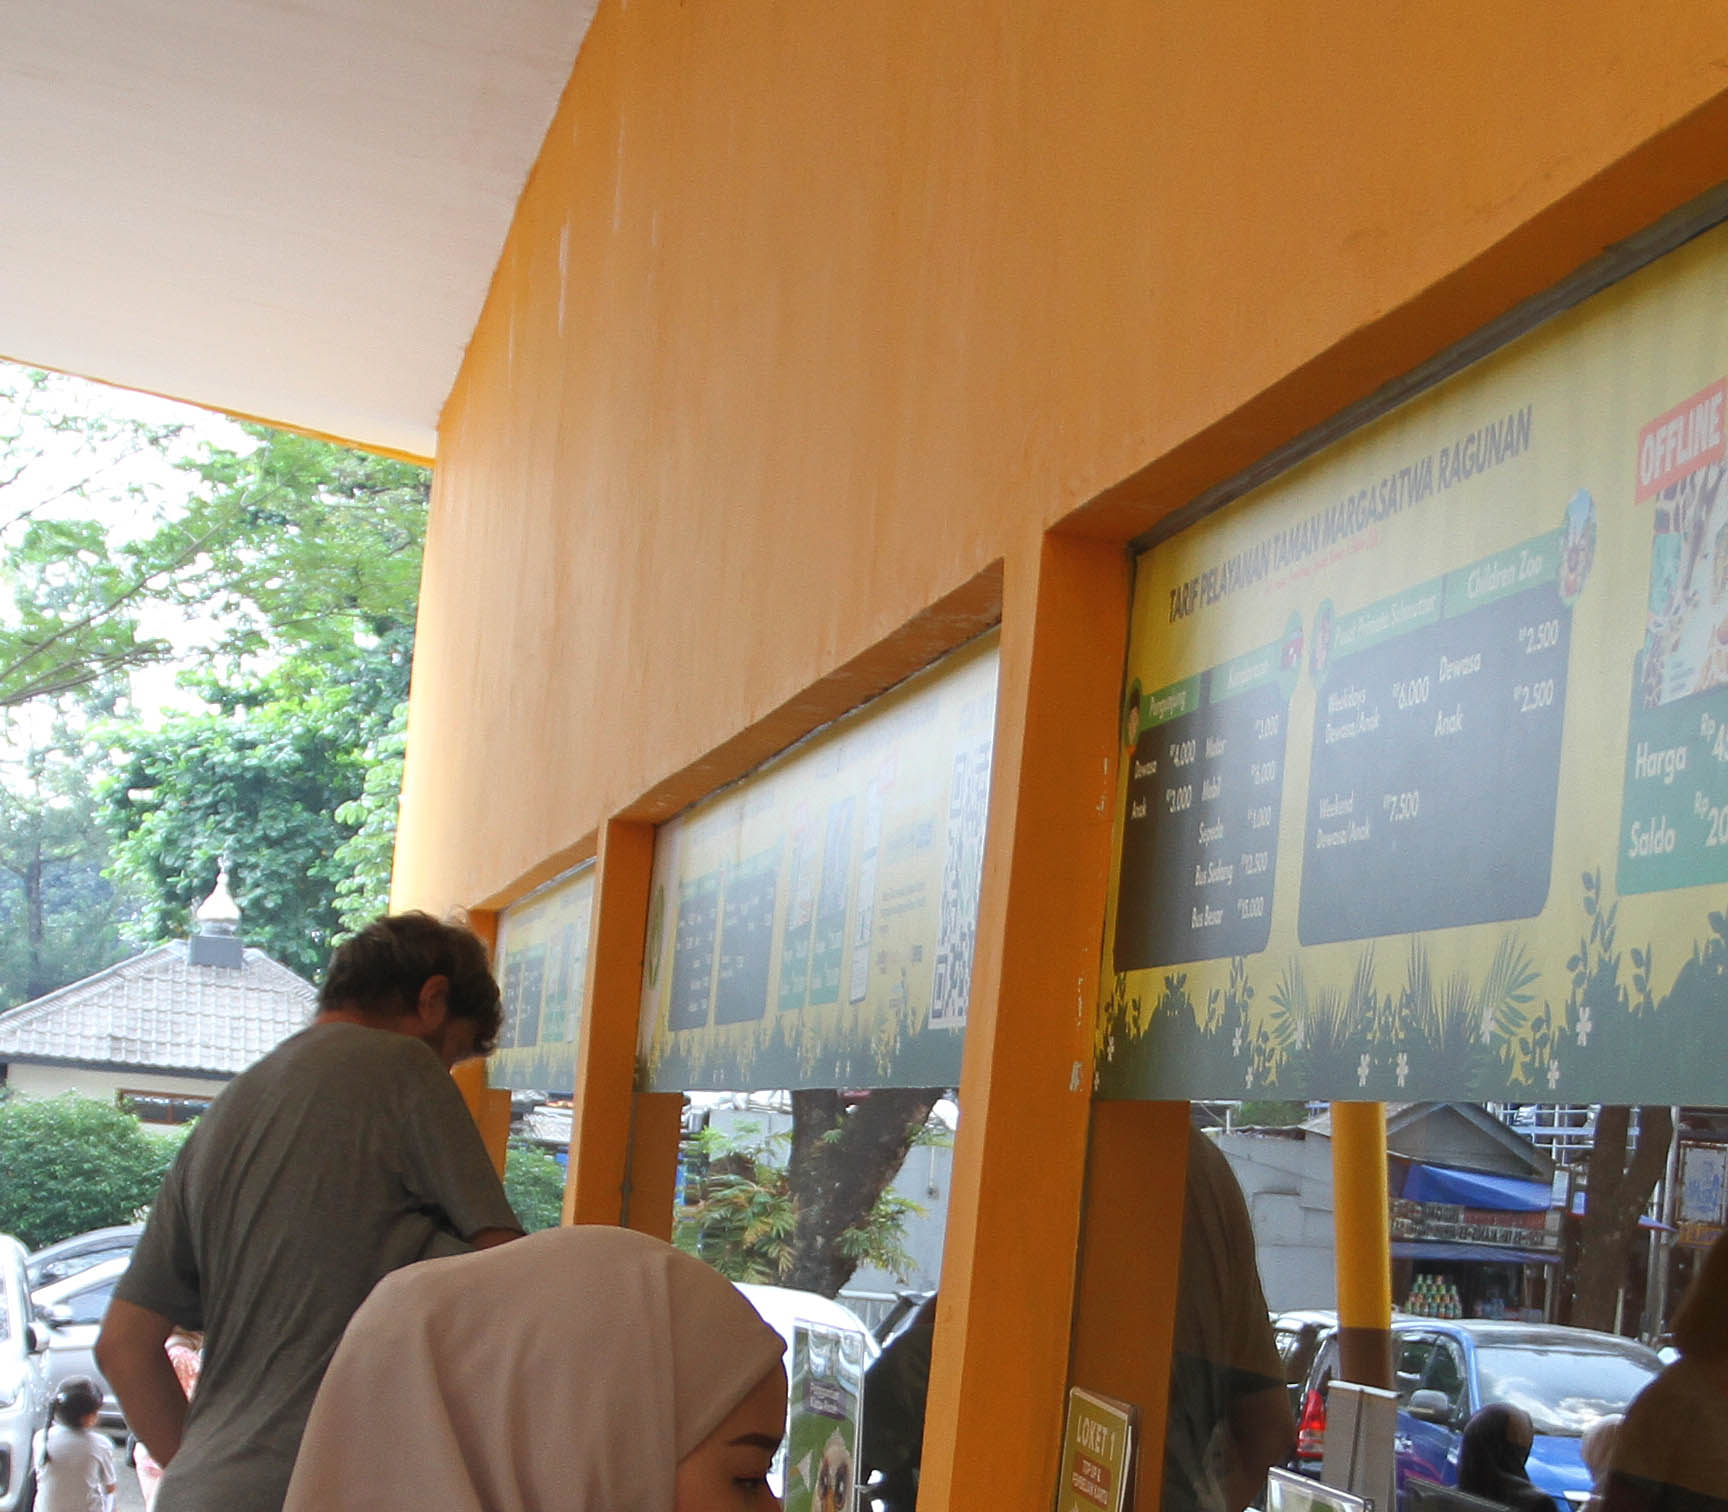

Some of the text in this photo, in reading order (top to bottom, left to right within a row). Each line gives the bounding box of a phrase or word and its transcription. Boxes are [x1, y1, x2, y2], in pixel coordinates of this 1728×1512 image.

[1640, 391, 1723, 487] OFFLINE
[1271, 512, 1321, 571] TAMAN
[1323, 455, 1432, 549] MARGASATWA
[1437, 403, 1532, 493] RAGUNAN
[1519, 550, 1542, 579] Zoo
[1438, 652, 1481, 683] Dewasa
[1434, 703, 1465, 737] Anak
[1634, 742, 1688, 785] Harga
[1628, 816, 1677, 859] Saldo
